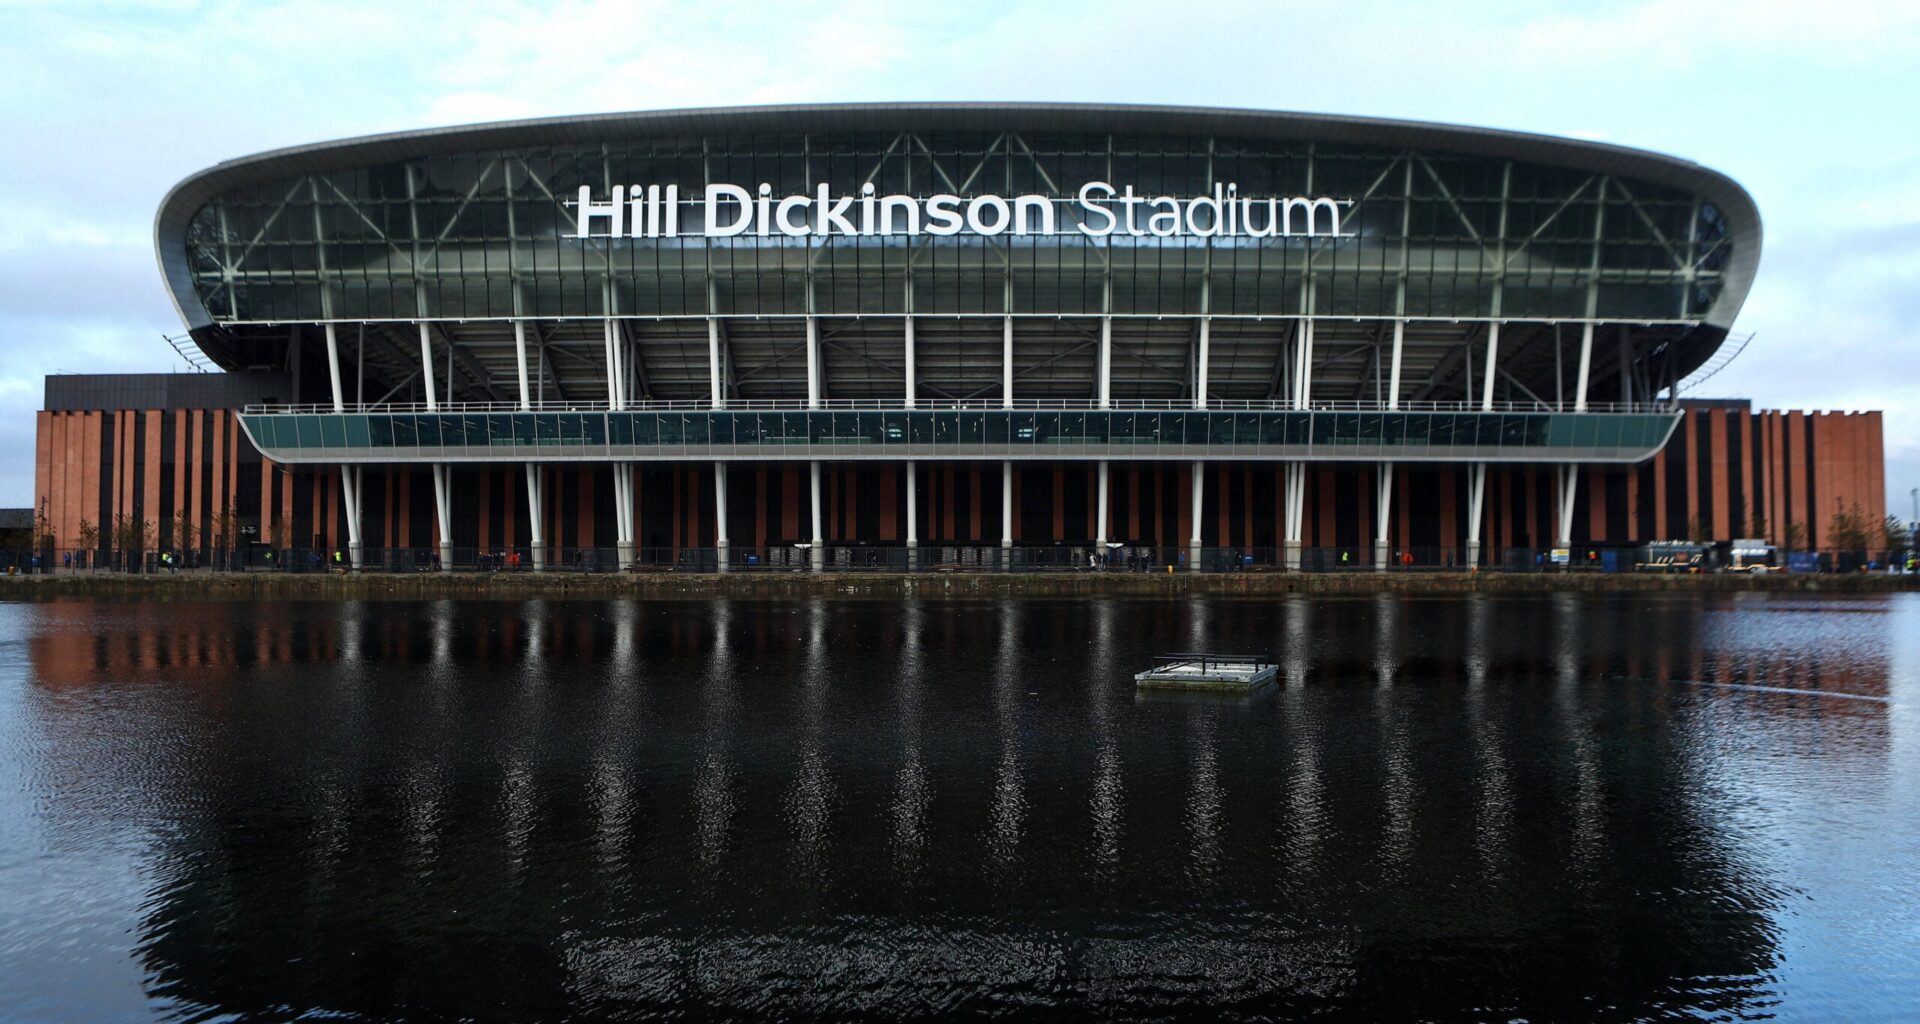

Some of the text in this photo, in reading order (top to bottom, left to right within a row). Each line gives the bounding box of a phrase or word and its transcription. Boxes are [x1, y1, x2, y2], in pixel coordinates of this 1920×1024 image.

[577, 181, 1341, 238] Hill Dickinson Stadium
